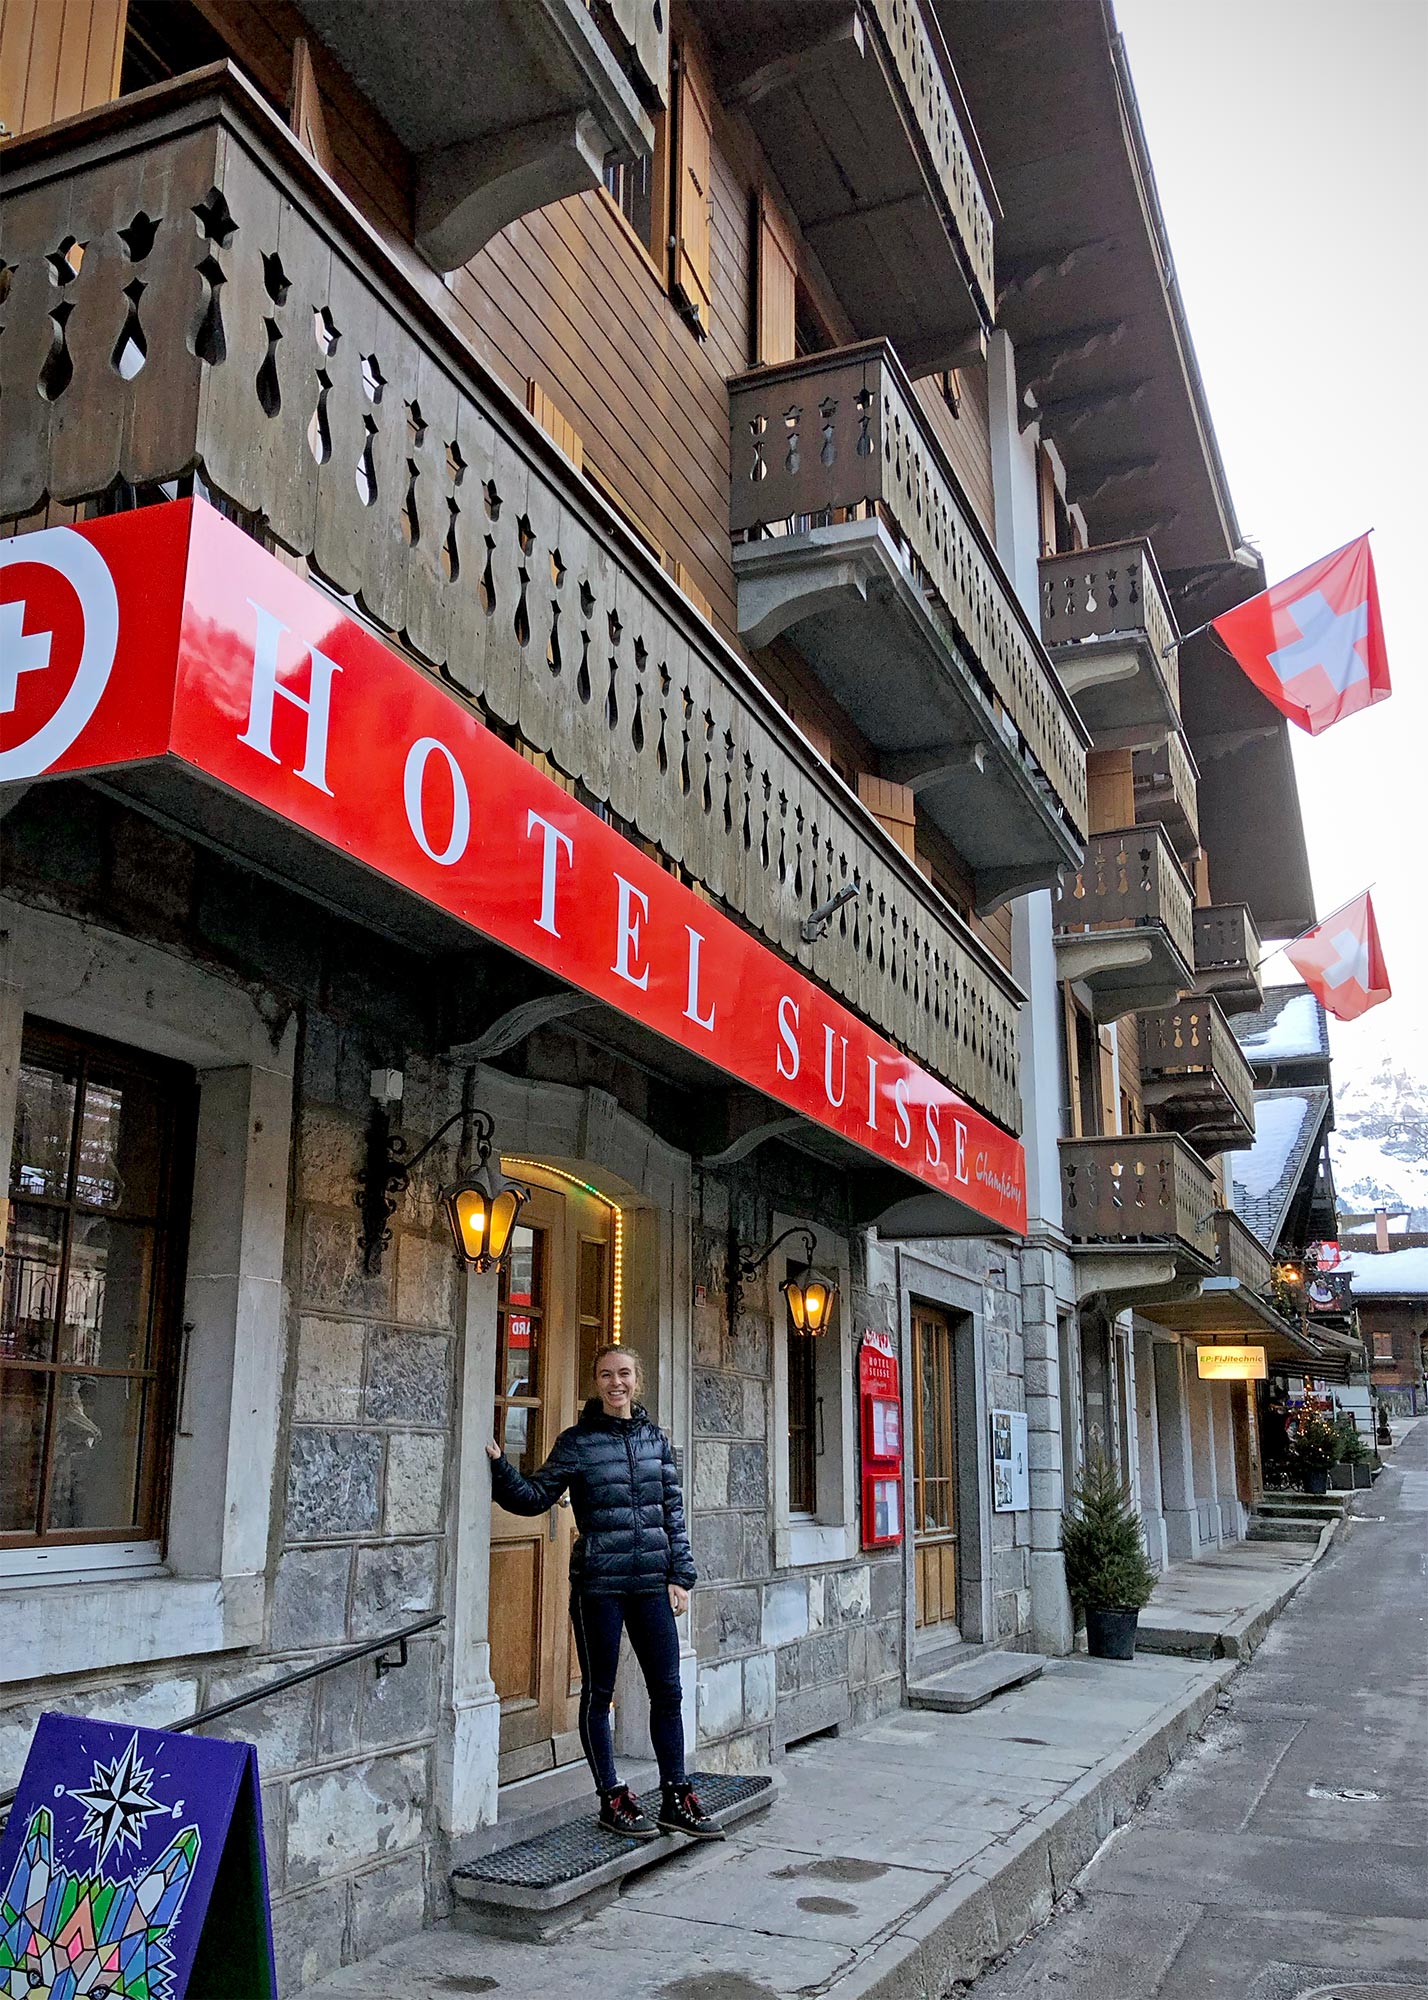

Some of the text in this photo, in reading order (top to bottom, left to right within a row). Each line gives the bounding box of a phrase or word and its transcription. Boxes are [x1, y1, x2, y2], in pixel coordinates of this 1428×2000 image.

[237, 597, 969, 1185] HOTEL SUISSE
[868, 1357, 890, 1369] HOTEL
[869, 1367, 890, 1379] SUISSE
[171, 1799, 186, 1819] E
